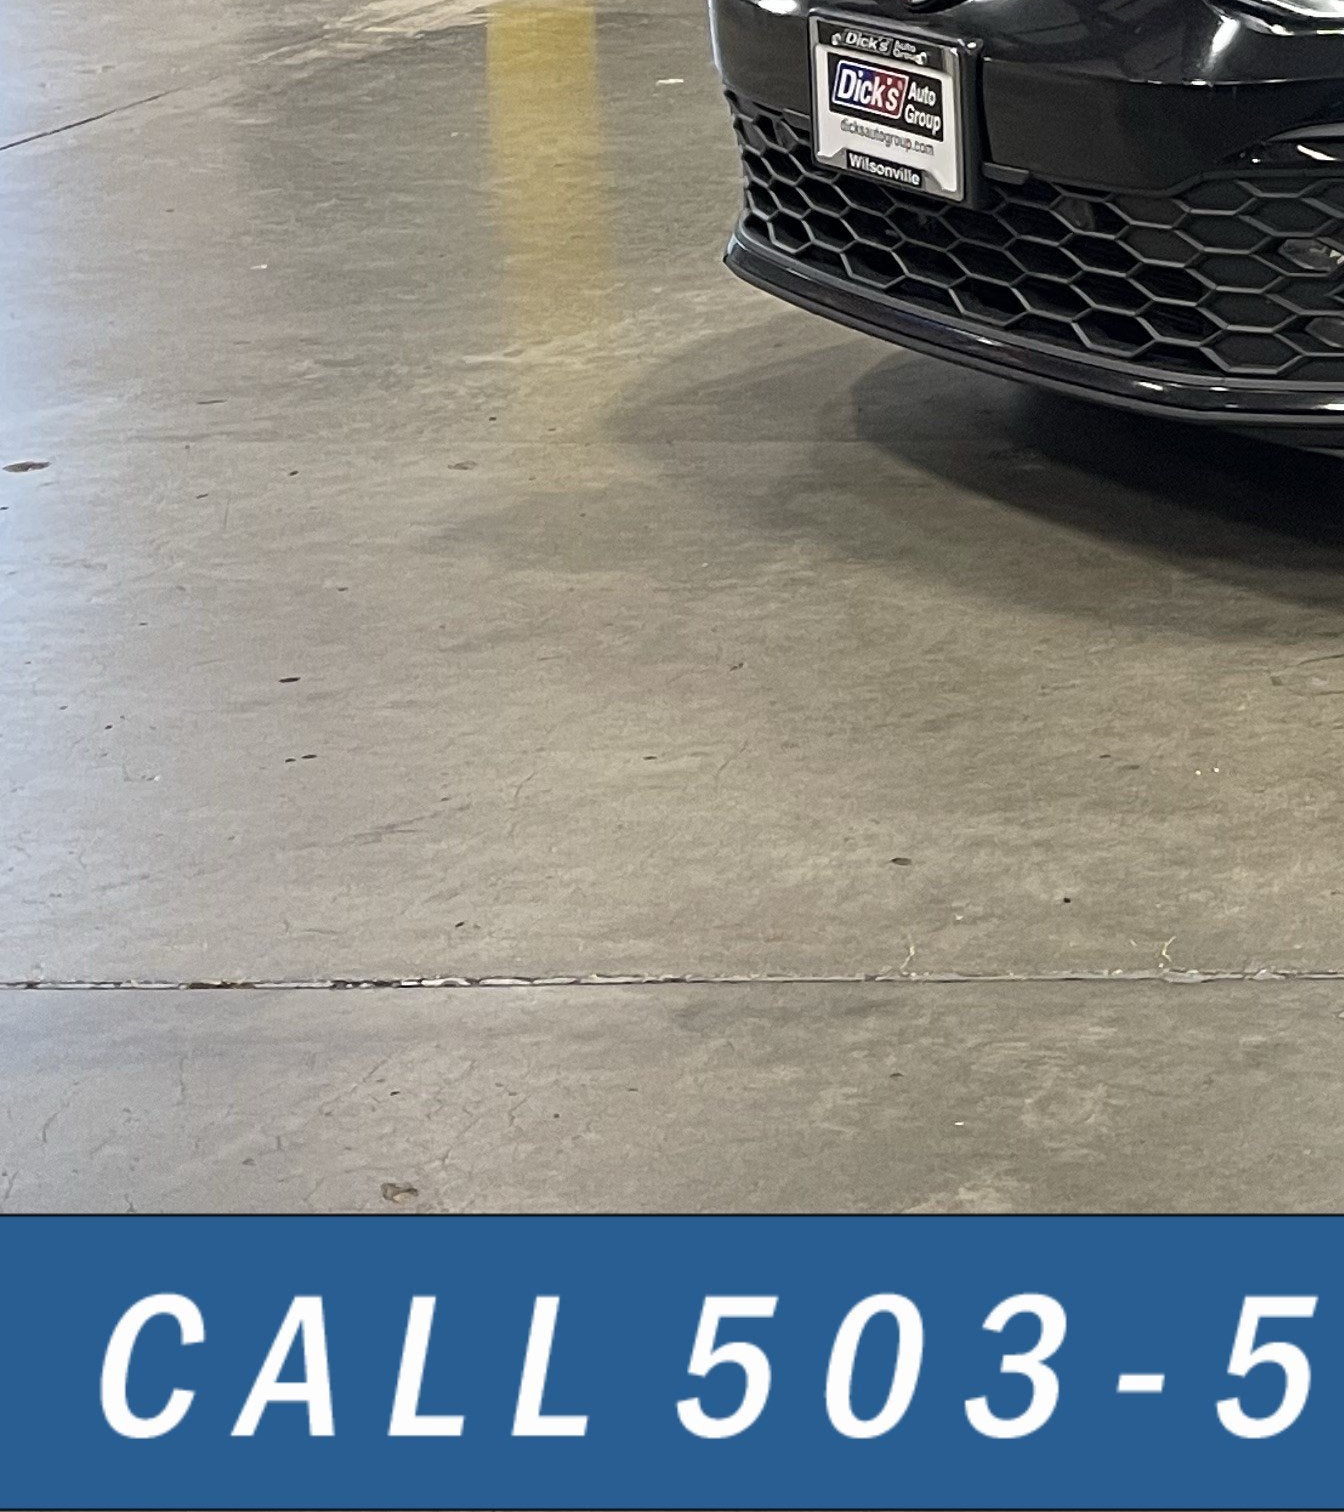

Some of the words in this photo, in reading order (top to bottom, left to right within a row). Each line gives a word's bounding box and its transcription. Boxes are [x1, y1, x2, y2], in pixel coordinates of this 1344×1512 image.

[845, 29, 888, 53] Dick's
[837, 68, 901, 112] Dick's
[907, 81, 937, 107] Auto
[904, 104, 942, 134] Group
[840, 117, 935, 157] dicksautogroup.com
[849, 152, 921, 186] Wilsonville
